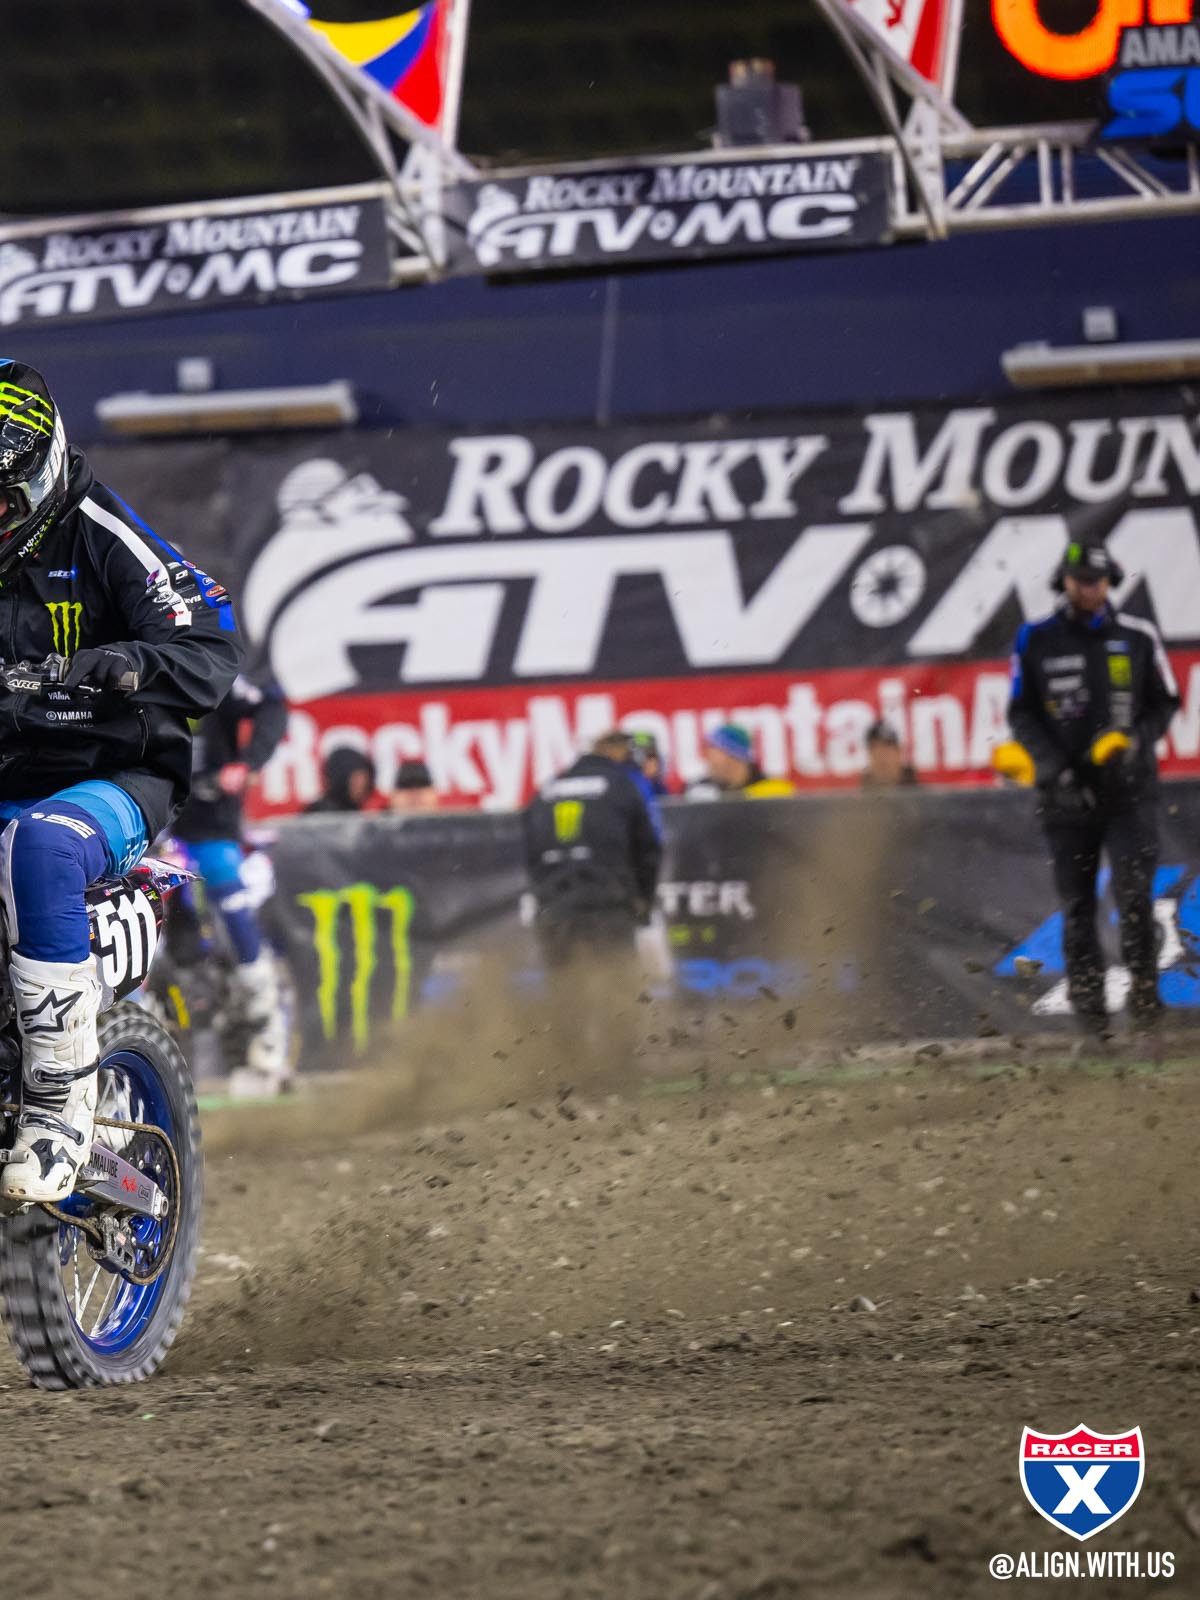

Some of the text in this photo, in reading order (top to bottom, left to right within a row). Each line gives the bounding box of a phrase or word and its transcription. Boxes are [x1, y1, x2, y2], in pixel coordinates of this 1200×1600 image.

[648, 158, 858, 203] MOUNTAIN
[428, 434, 827, 537] ROCKY
[7, 678, 41, 690] ARC
[57, 711, 93, 721] YAMAHA
[95, 888, 157, 988] 511
[89, 1151, 119, 1178] AMALUBE
